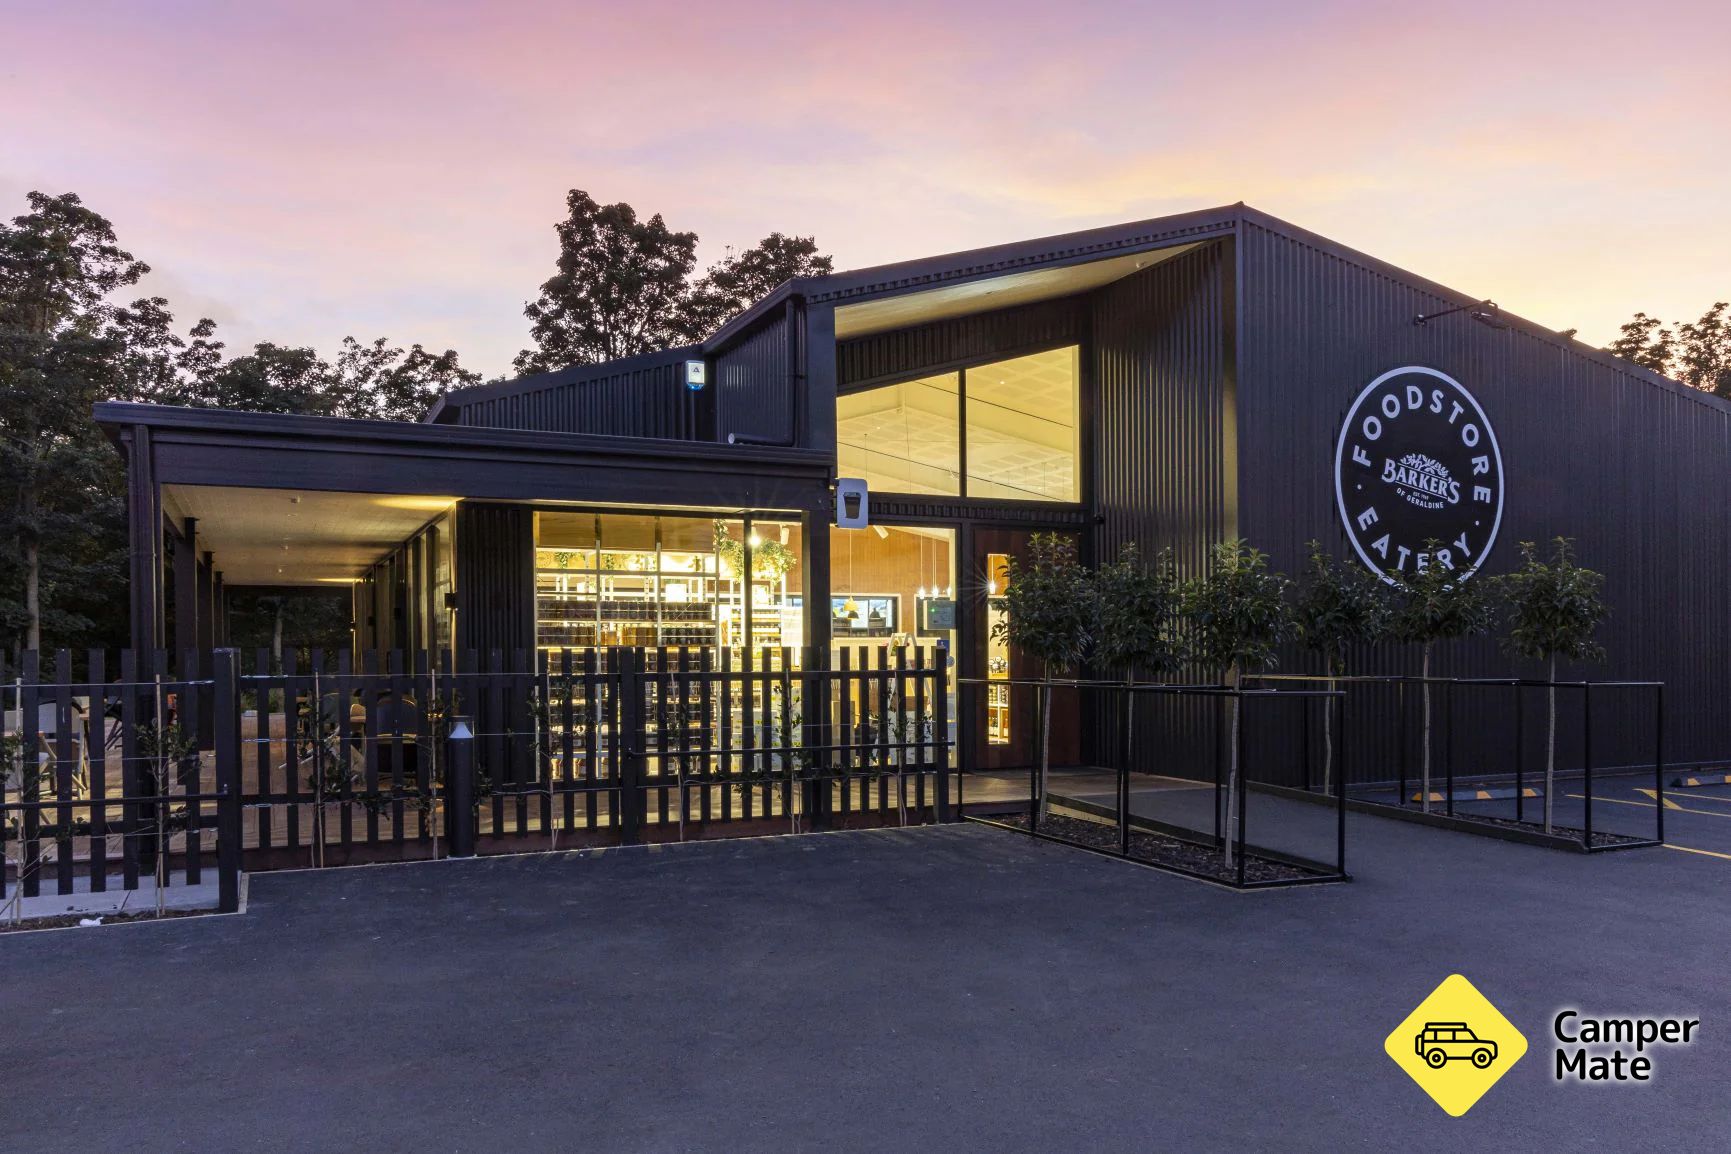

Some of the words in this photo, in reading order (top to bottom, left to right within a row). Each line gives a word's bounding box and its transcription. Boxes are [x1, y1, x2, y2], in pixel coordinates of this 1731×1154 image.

[1352, 385, 1491, 504] FOODSTORE
[1381, 458, 1460, 504] BARKER'S
[1396, 487, 1406, 497] OF
[1406, 494, 1444, 509] GERALDINE
[1357, 506, 1471, 575] EATERY
